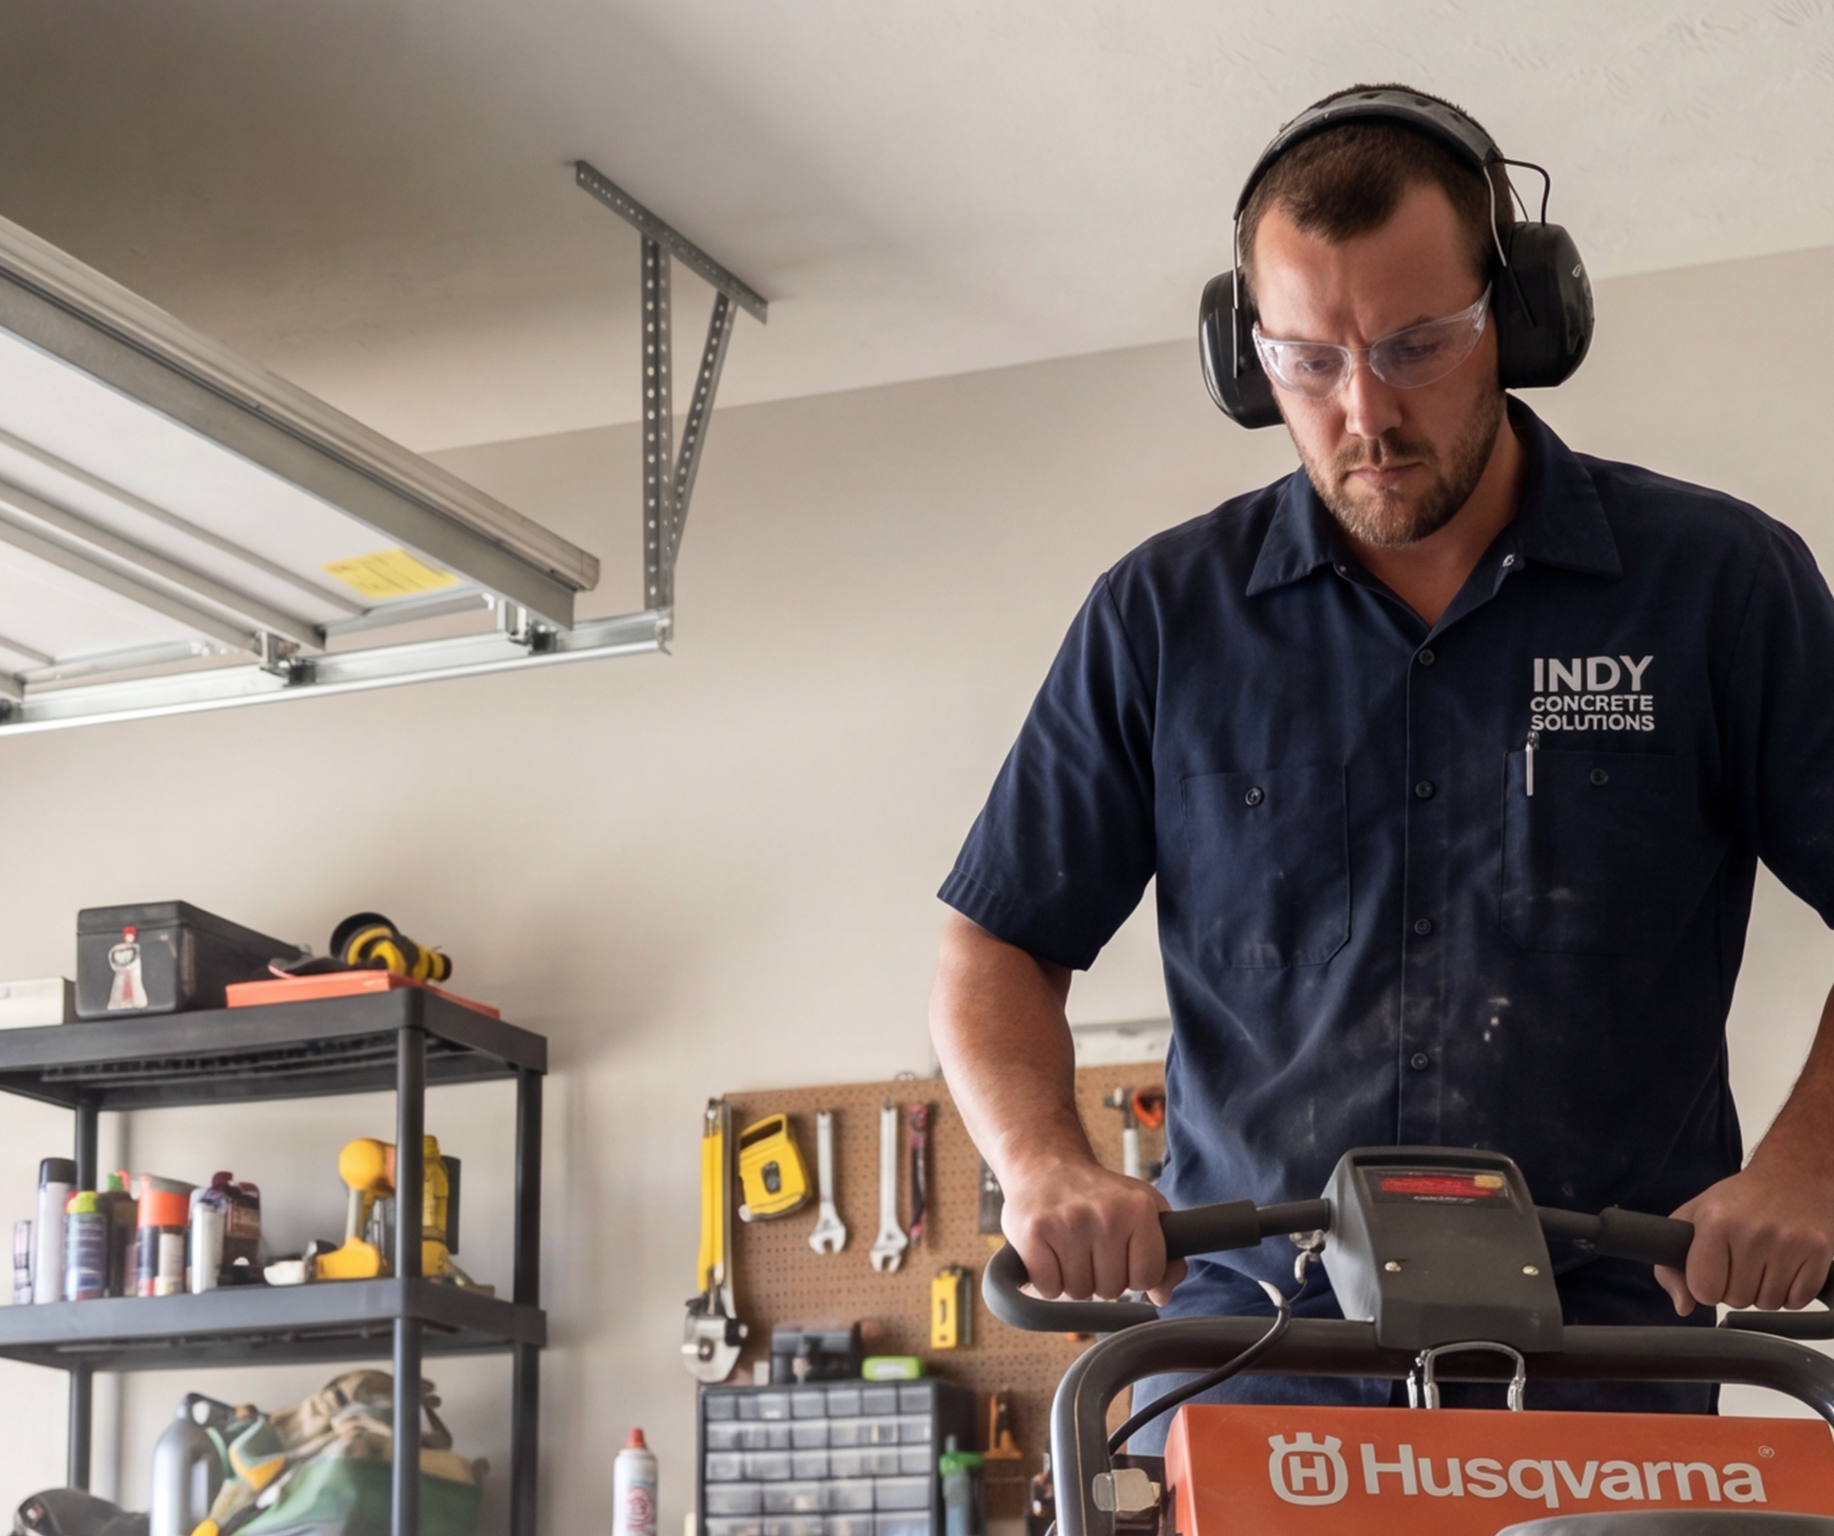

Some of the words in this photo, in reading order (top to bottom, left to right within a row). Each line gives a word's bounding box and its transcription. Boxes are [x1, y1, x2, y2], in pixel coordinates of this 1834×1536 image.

[1533, 655, 1654, 692] INDY
[1530, 695, 1654, 712] CONCRETE
[1531, 714, 1655, 731] SOLUTIONS
[1360, 1443, 1767, 1509] Husqvarna
